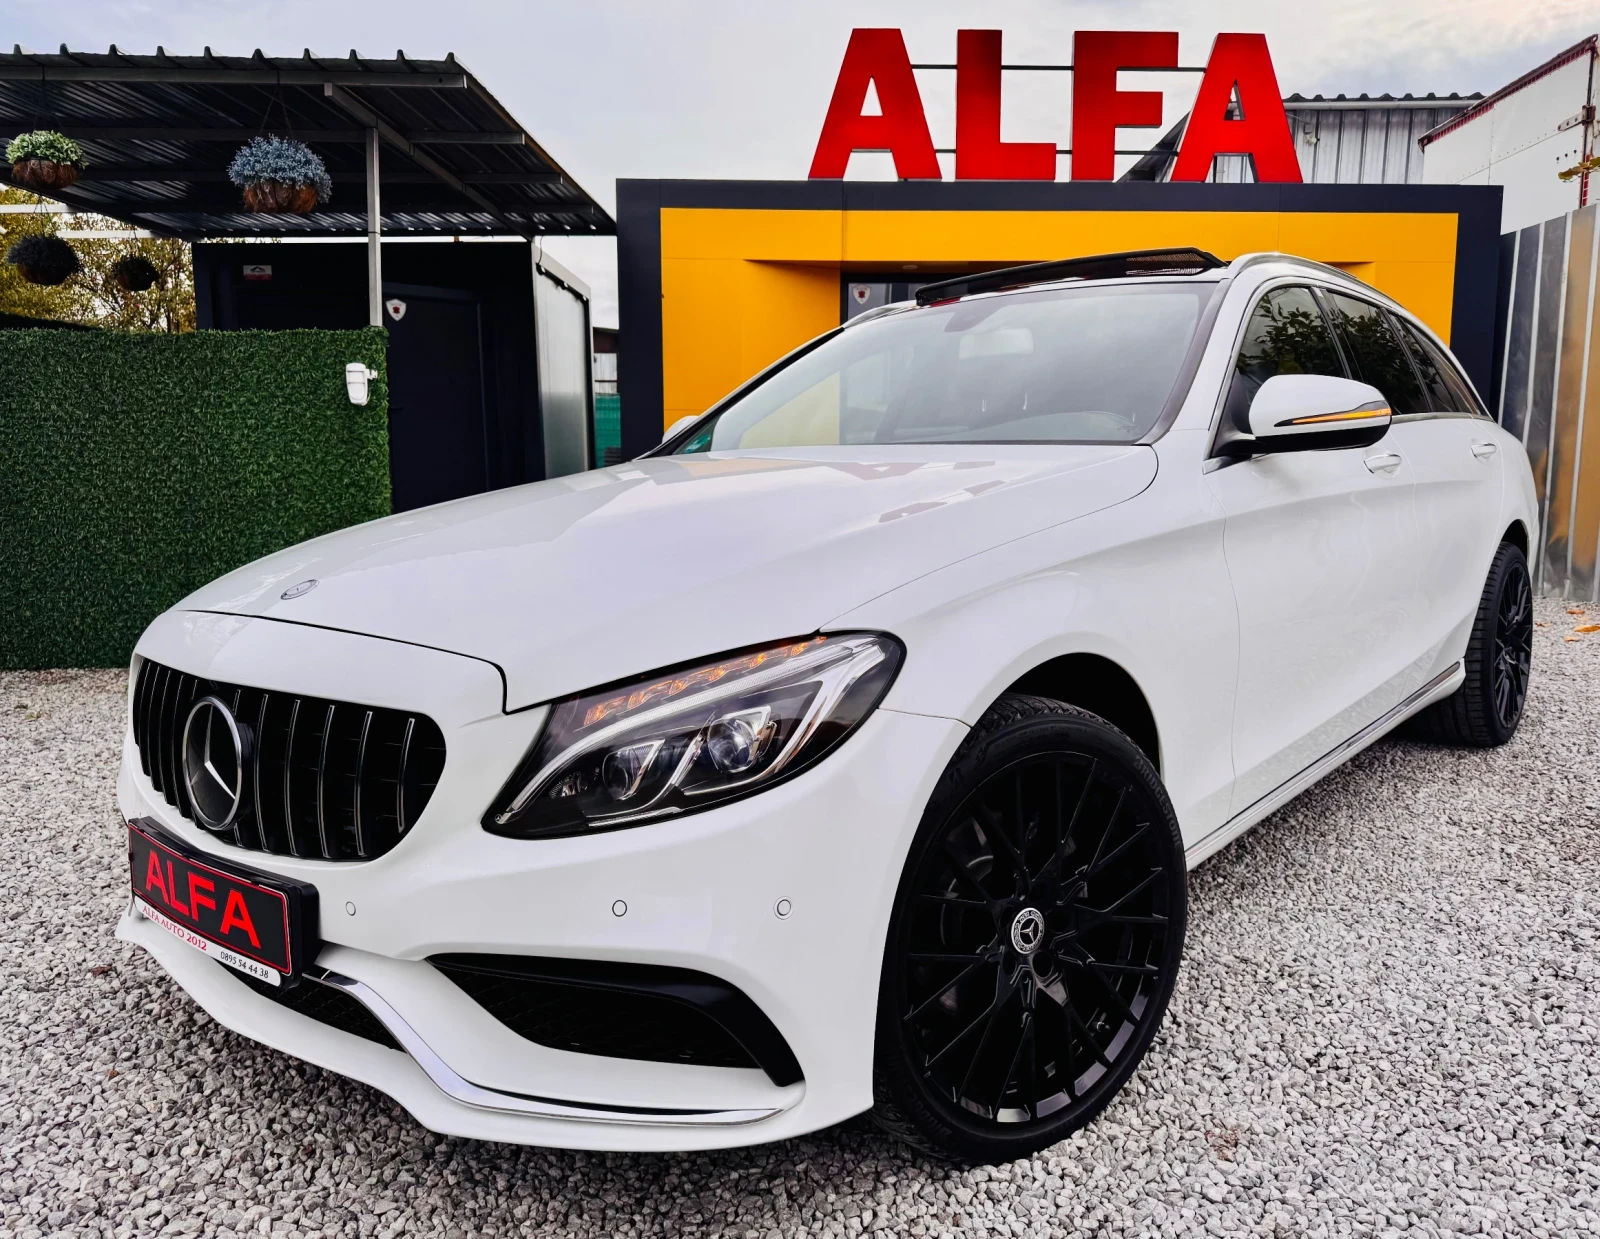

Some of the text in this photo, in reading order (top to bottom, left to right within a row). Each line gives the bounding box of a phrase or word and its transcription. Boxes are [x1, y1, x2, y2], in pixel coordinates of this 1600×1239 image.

[807, 28, 1304, 183] ALFA
[1133, 753, 1183, 851] BRIDGESTONE
[142, 905, 207, 951] ALFA AUTO 2012
[146, 850, 262, 949] ALFA
[220, 951, 269, 979] 0895 54 44 38
